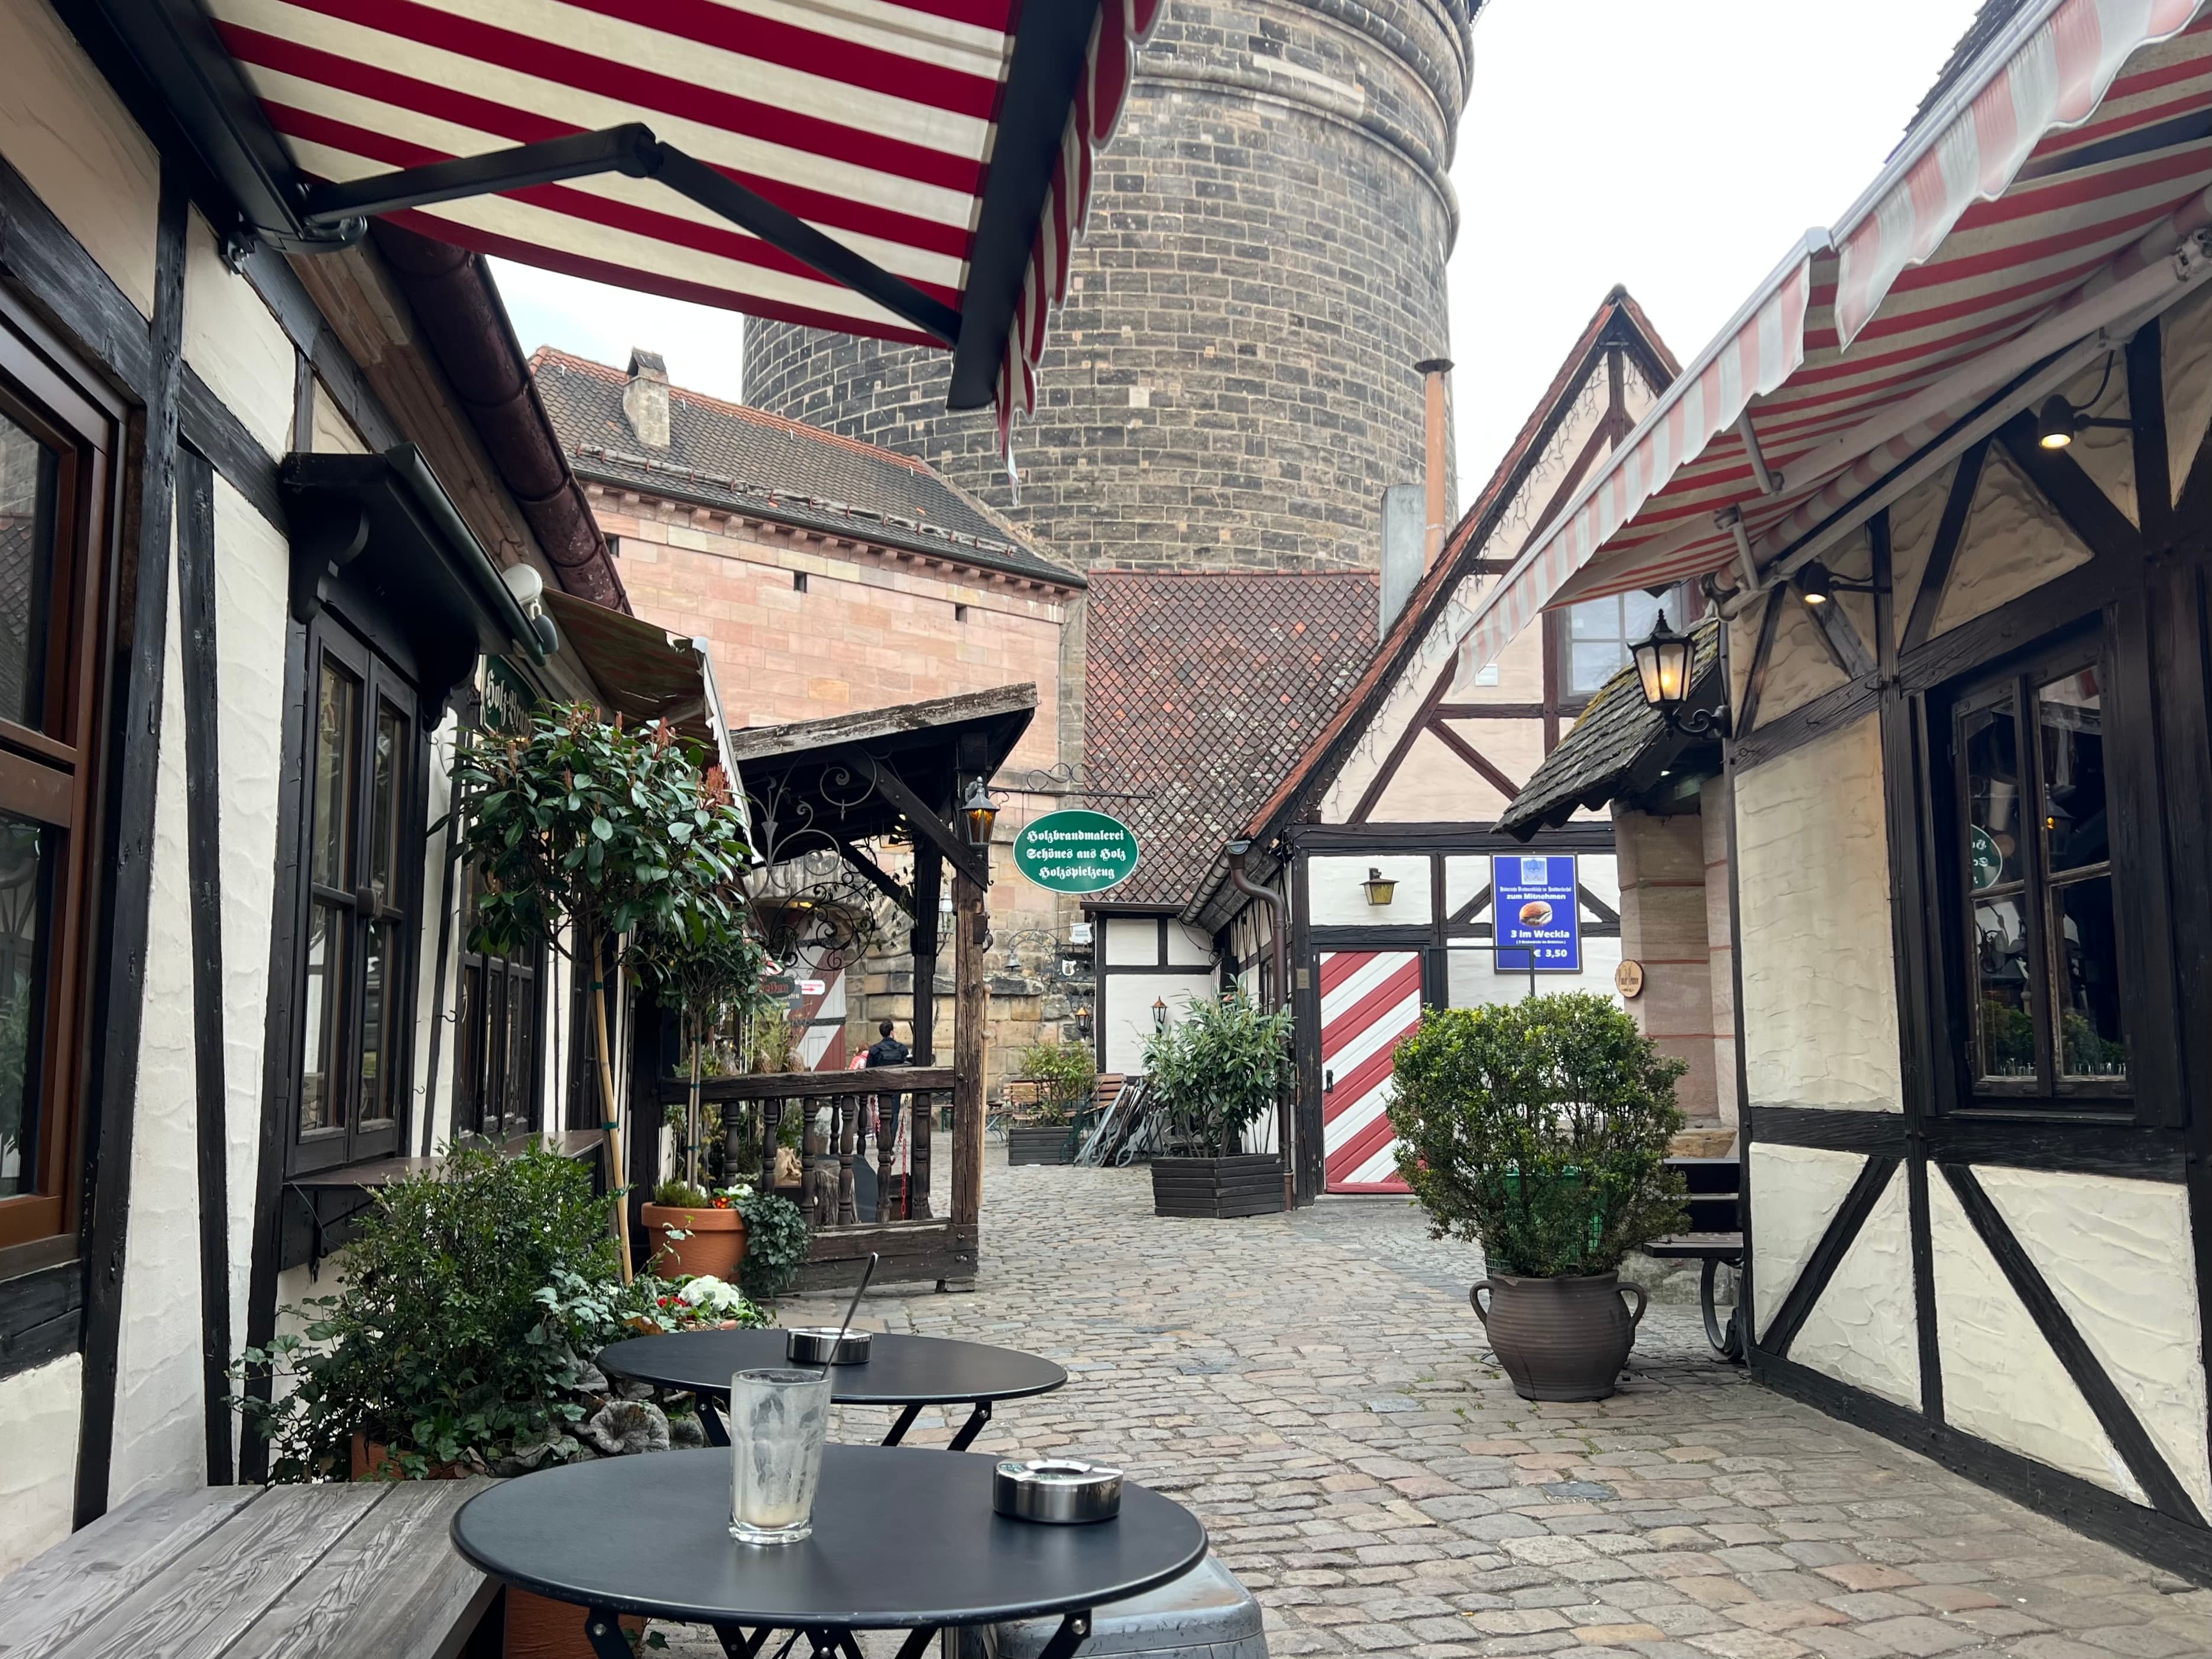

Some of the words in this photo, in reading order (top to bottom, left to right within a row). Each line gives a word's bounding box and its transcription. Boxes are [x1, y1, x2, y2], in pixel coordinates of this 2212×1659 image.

[1026, 830, 1124, 844] Holzbrandmalerei
[1026, 848, 1073, 861] Schönes
[1077, 848, 1097, 858] aus
[1100, 848, 1126, 861] Holz
[1039, 866, 1115, 880] Holzspielzeug
[1510, 929, 1517, 938] 3
[1533, 929, 1570, 938] Weckla
[1533, 949, 1541, 958] €
[1545, 948, 1567, 959] 3,50
